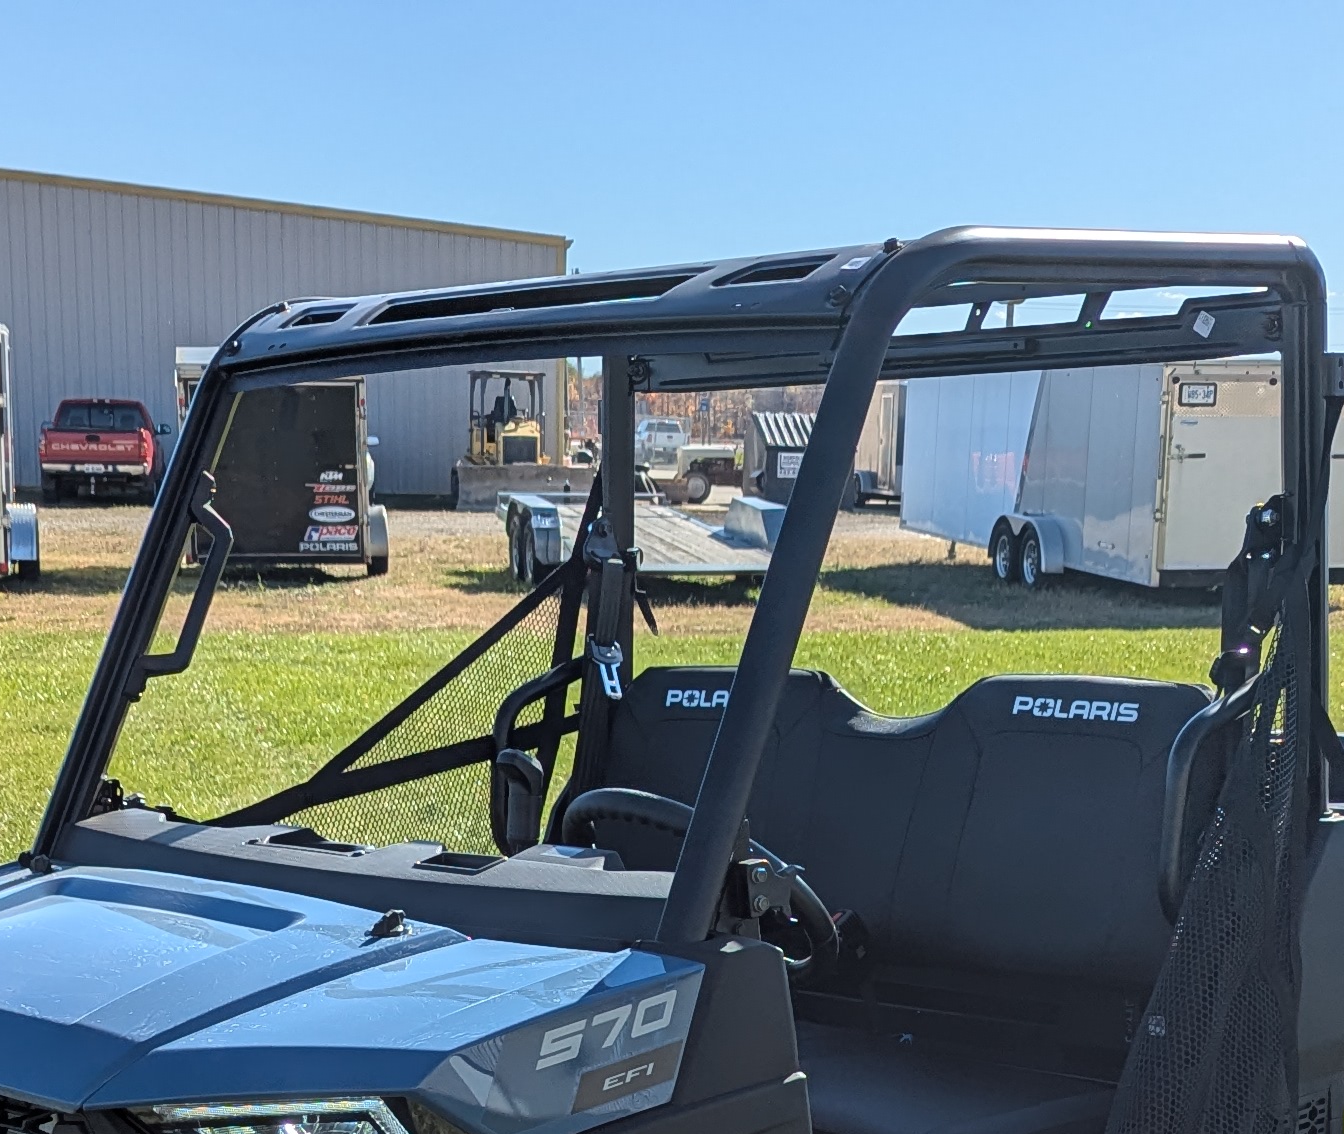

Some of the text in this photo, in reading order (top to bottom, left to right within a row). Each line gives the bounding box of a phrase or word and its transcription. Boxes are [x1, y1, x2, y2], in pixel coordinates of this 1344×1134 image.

[51, 442, 135, 452] CHEVROLET
[319, 470, 343, 483] KTM
[314, 495, 349, 505] STIHL
[299, 542, 358, 552] POLARIS
[665, 689, 730, 708] POLA
[1012, 695, 1140, 722] POLARIS
[535, 989, 678, 1071] 570
[602, 1062, 655, 1092] EFI
